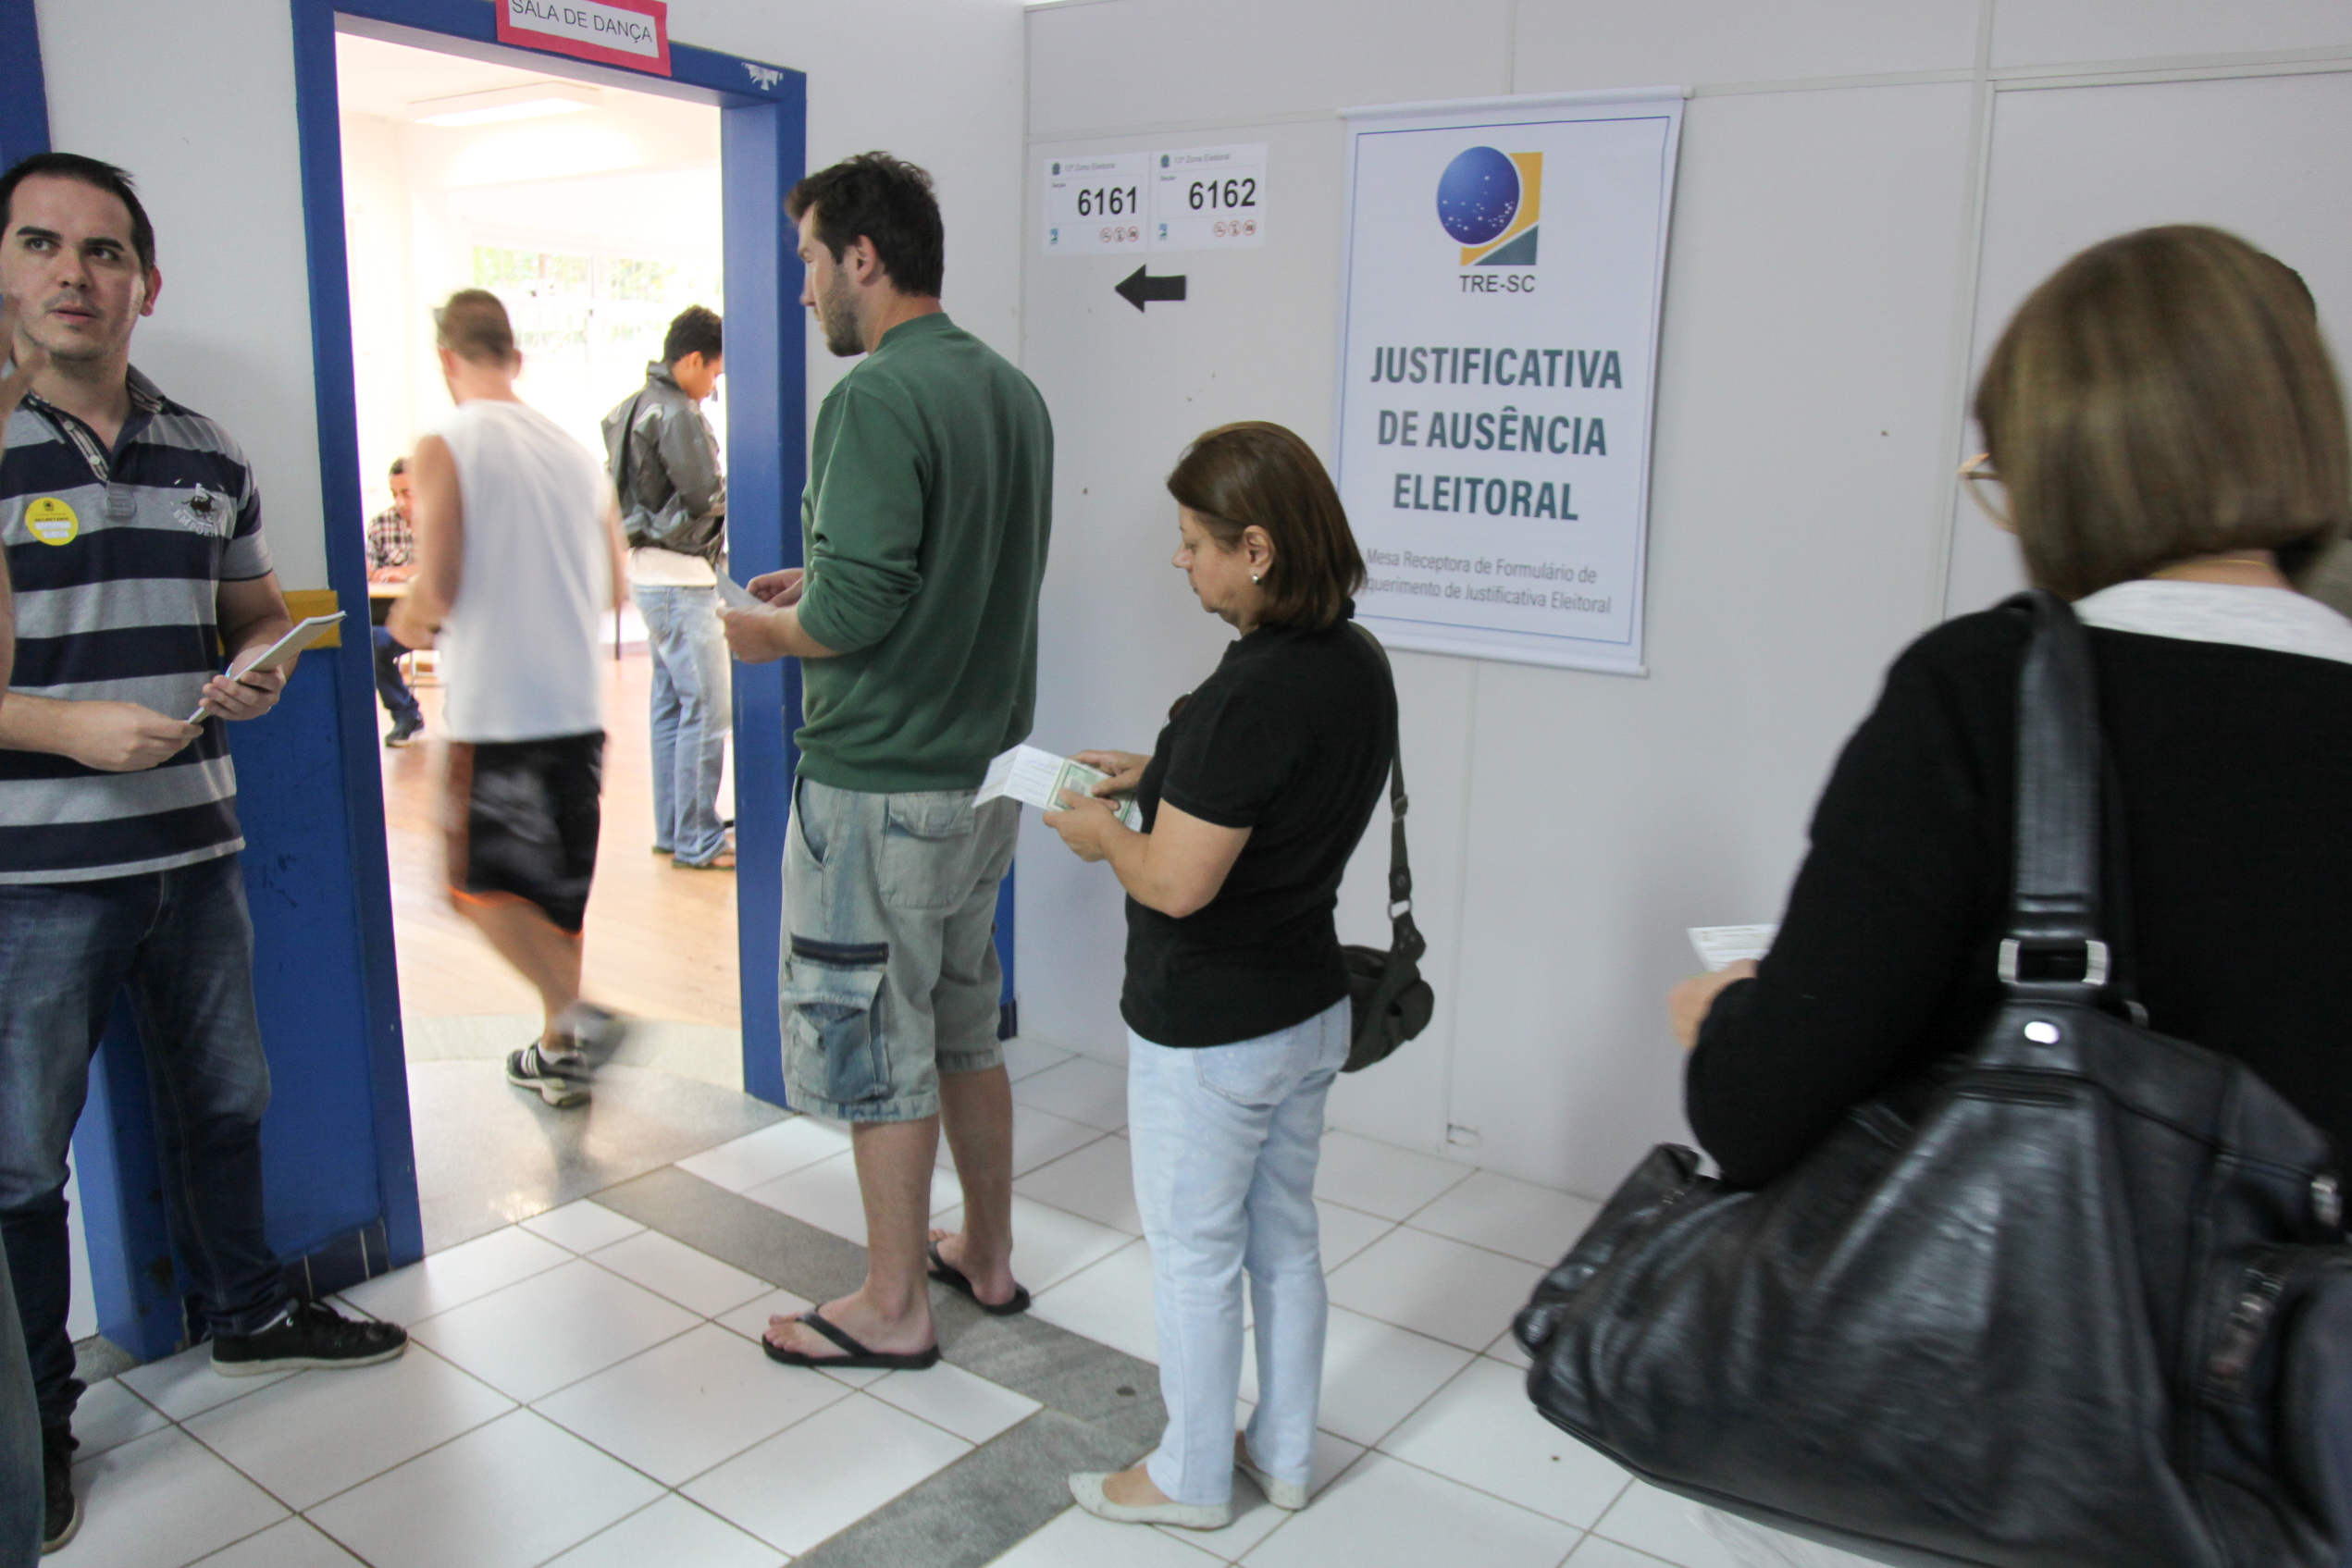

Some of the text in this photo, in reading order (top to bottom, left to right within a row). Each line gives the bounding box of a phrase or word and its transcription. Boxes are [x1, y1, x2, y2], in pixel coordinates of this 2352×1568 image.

[512, 0, 653, 43] SALA DE DANÇA
[1077, 186, 1137, 216] 6161
[1188, 178, 1256, 210] 6162
[1459, 275, 1536, 293] TRE-SC
[1370, 346, 1623, 389] JUSTIFICATIVA
[1378, 405, 1608, 456] DE AUSÊNCIA
[1393, 473, 1579, 521] ELEITORAL
[1367, 548, 1598, 584] Mesa Receptora de Formulário de
[1443, 581, 1462, 599] de
[1465, 584, 1547, 608] Justificativa
[1551, 591, 1613, 613] Eleitoral
